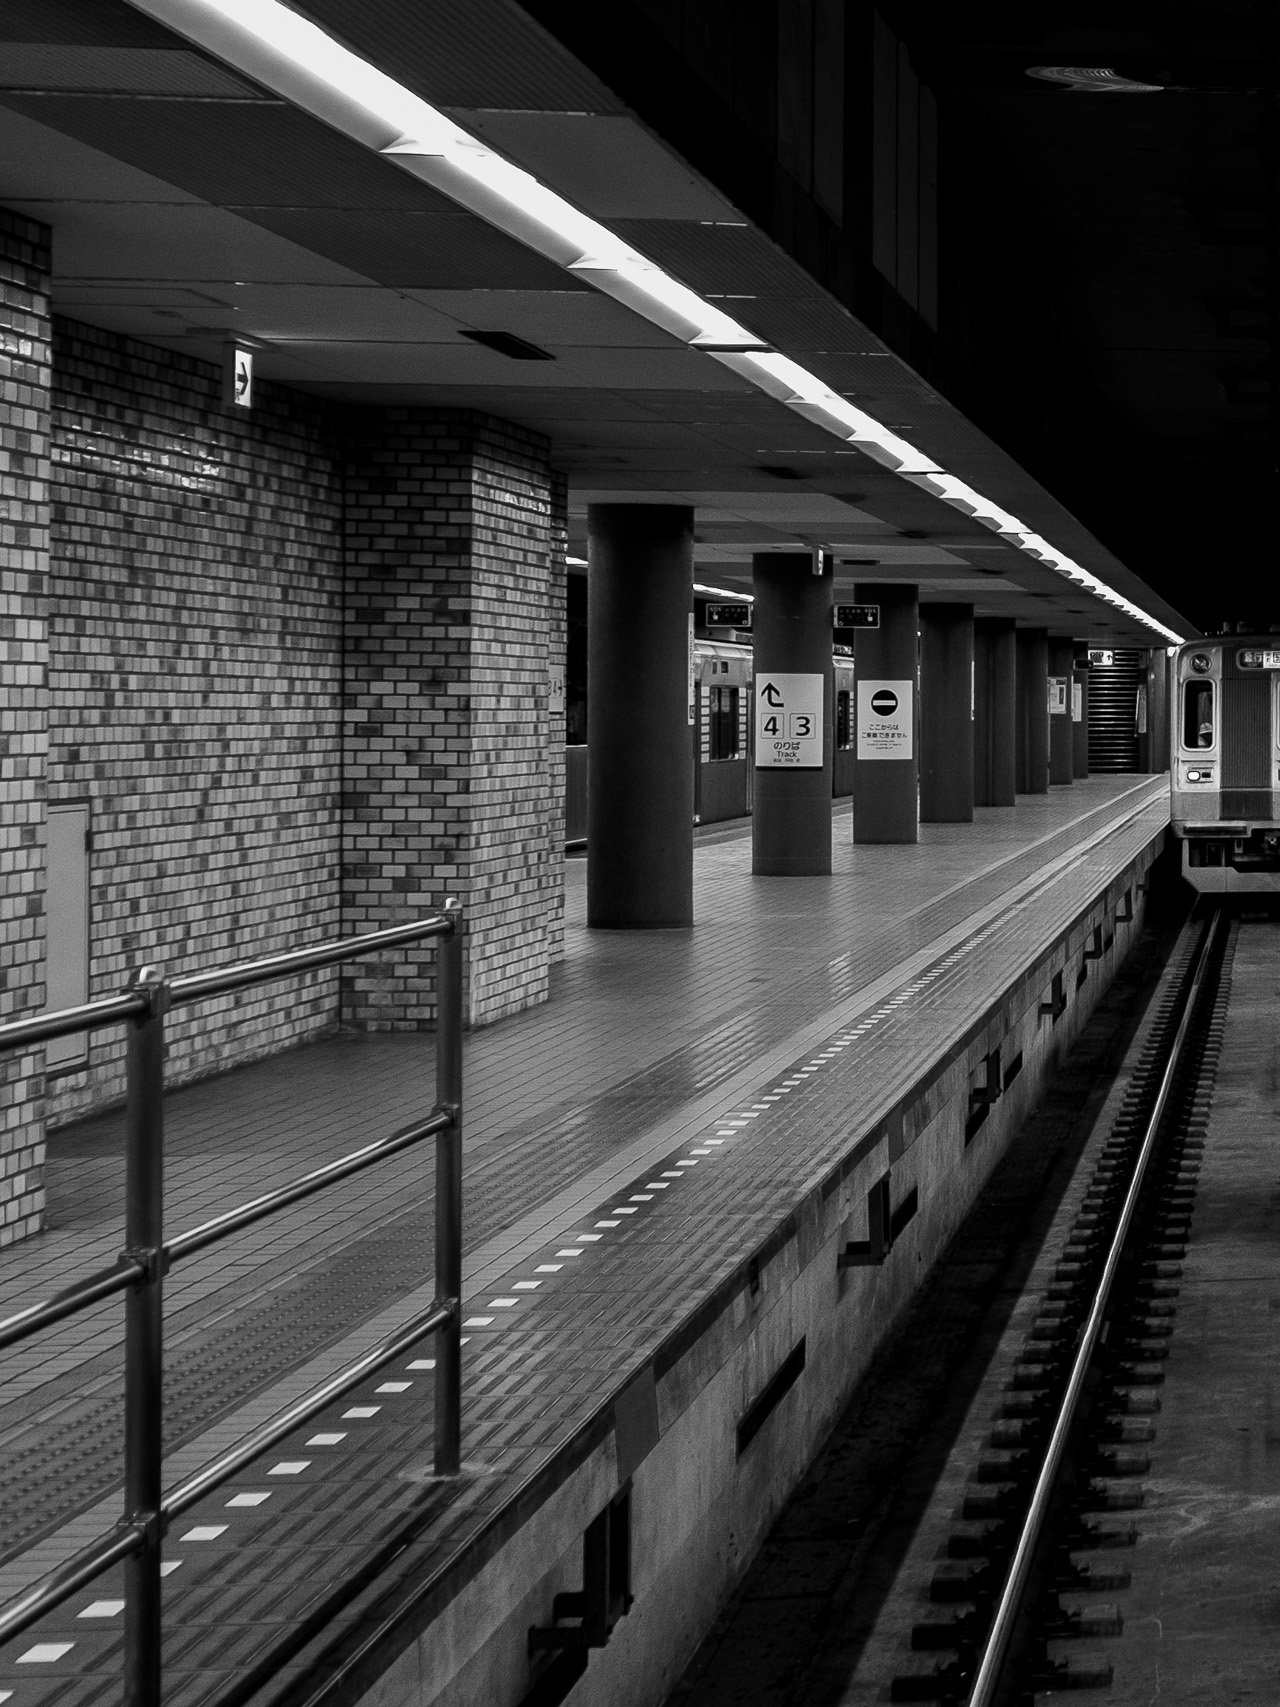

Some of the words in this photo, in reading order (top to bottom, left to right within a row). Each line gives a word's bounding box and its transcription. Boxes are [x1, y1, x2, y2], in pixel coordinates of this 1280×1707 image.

[763, 716, 779, 736] 4
[795, 716, 811, 737] 3
[773, 741, 801, 751] のりば
[777, 750, 798, 758] Track
